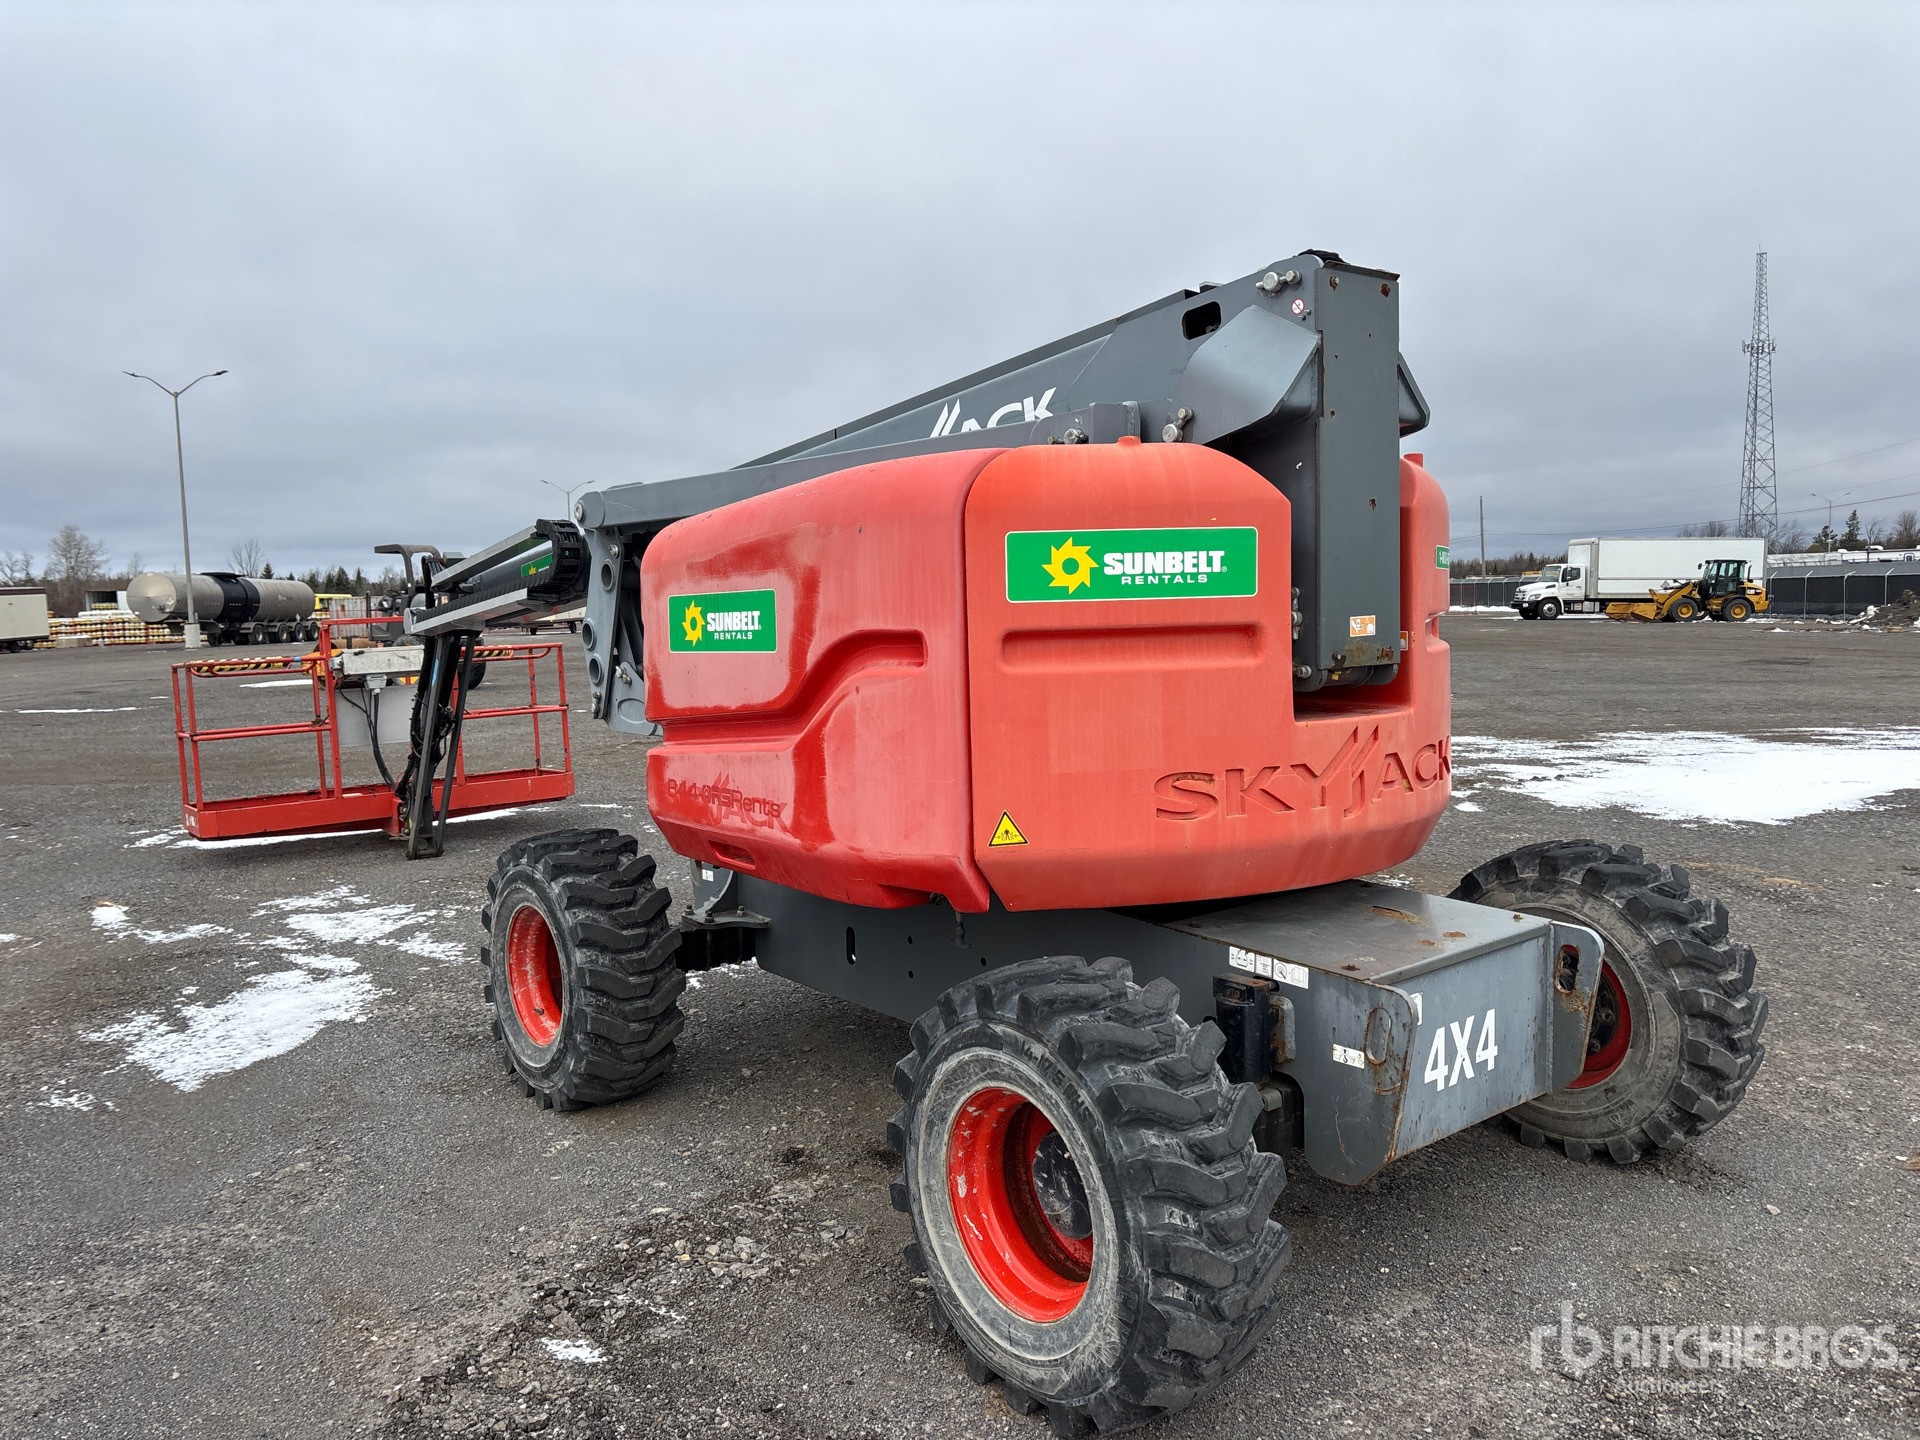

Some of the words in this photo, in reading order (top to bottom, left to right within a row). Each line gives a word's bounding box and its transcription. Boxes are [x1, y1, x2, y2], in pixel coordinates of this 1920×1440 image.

[1121, 574, 1208, 585] RENTALS
[706, 611, 760, 631] SUNBELT
[714, 632, 753, 640] RENTALS
[1424, 1008, 1498, 1092] 4X4
